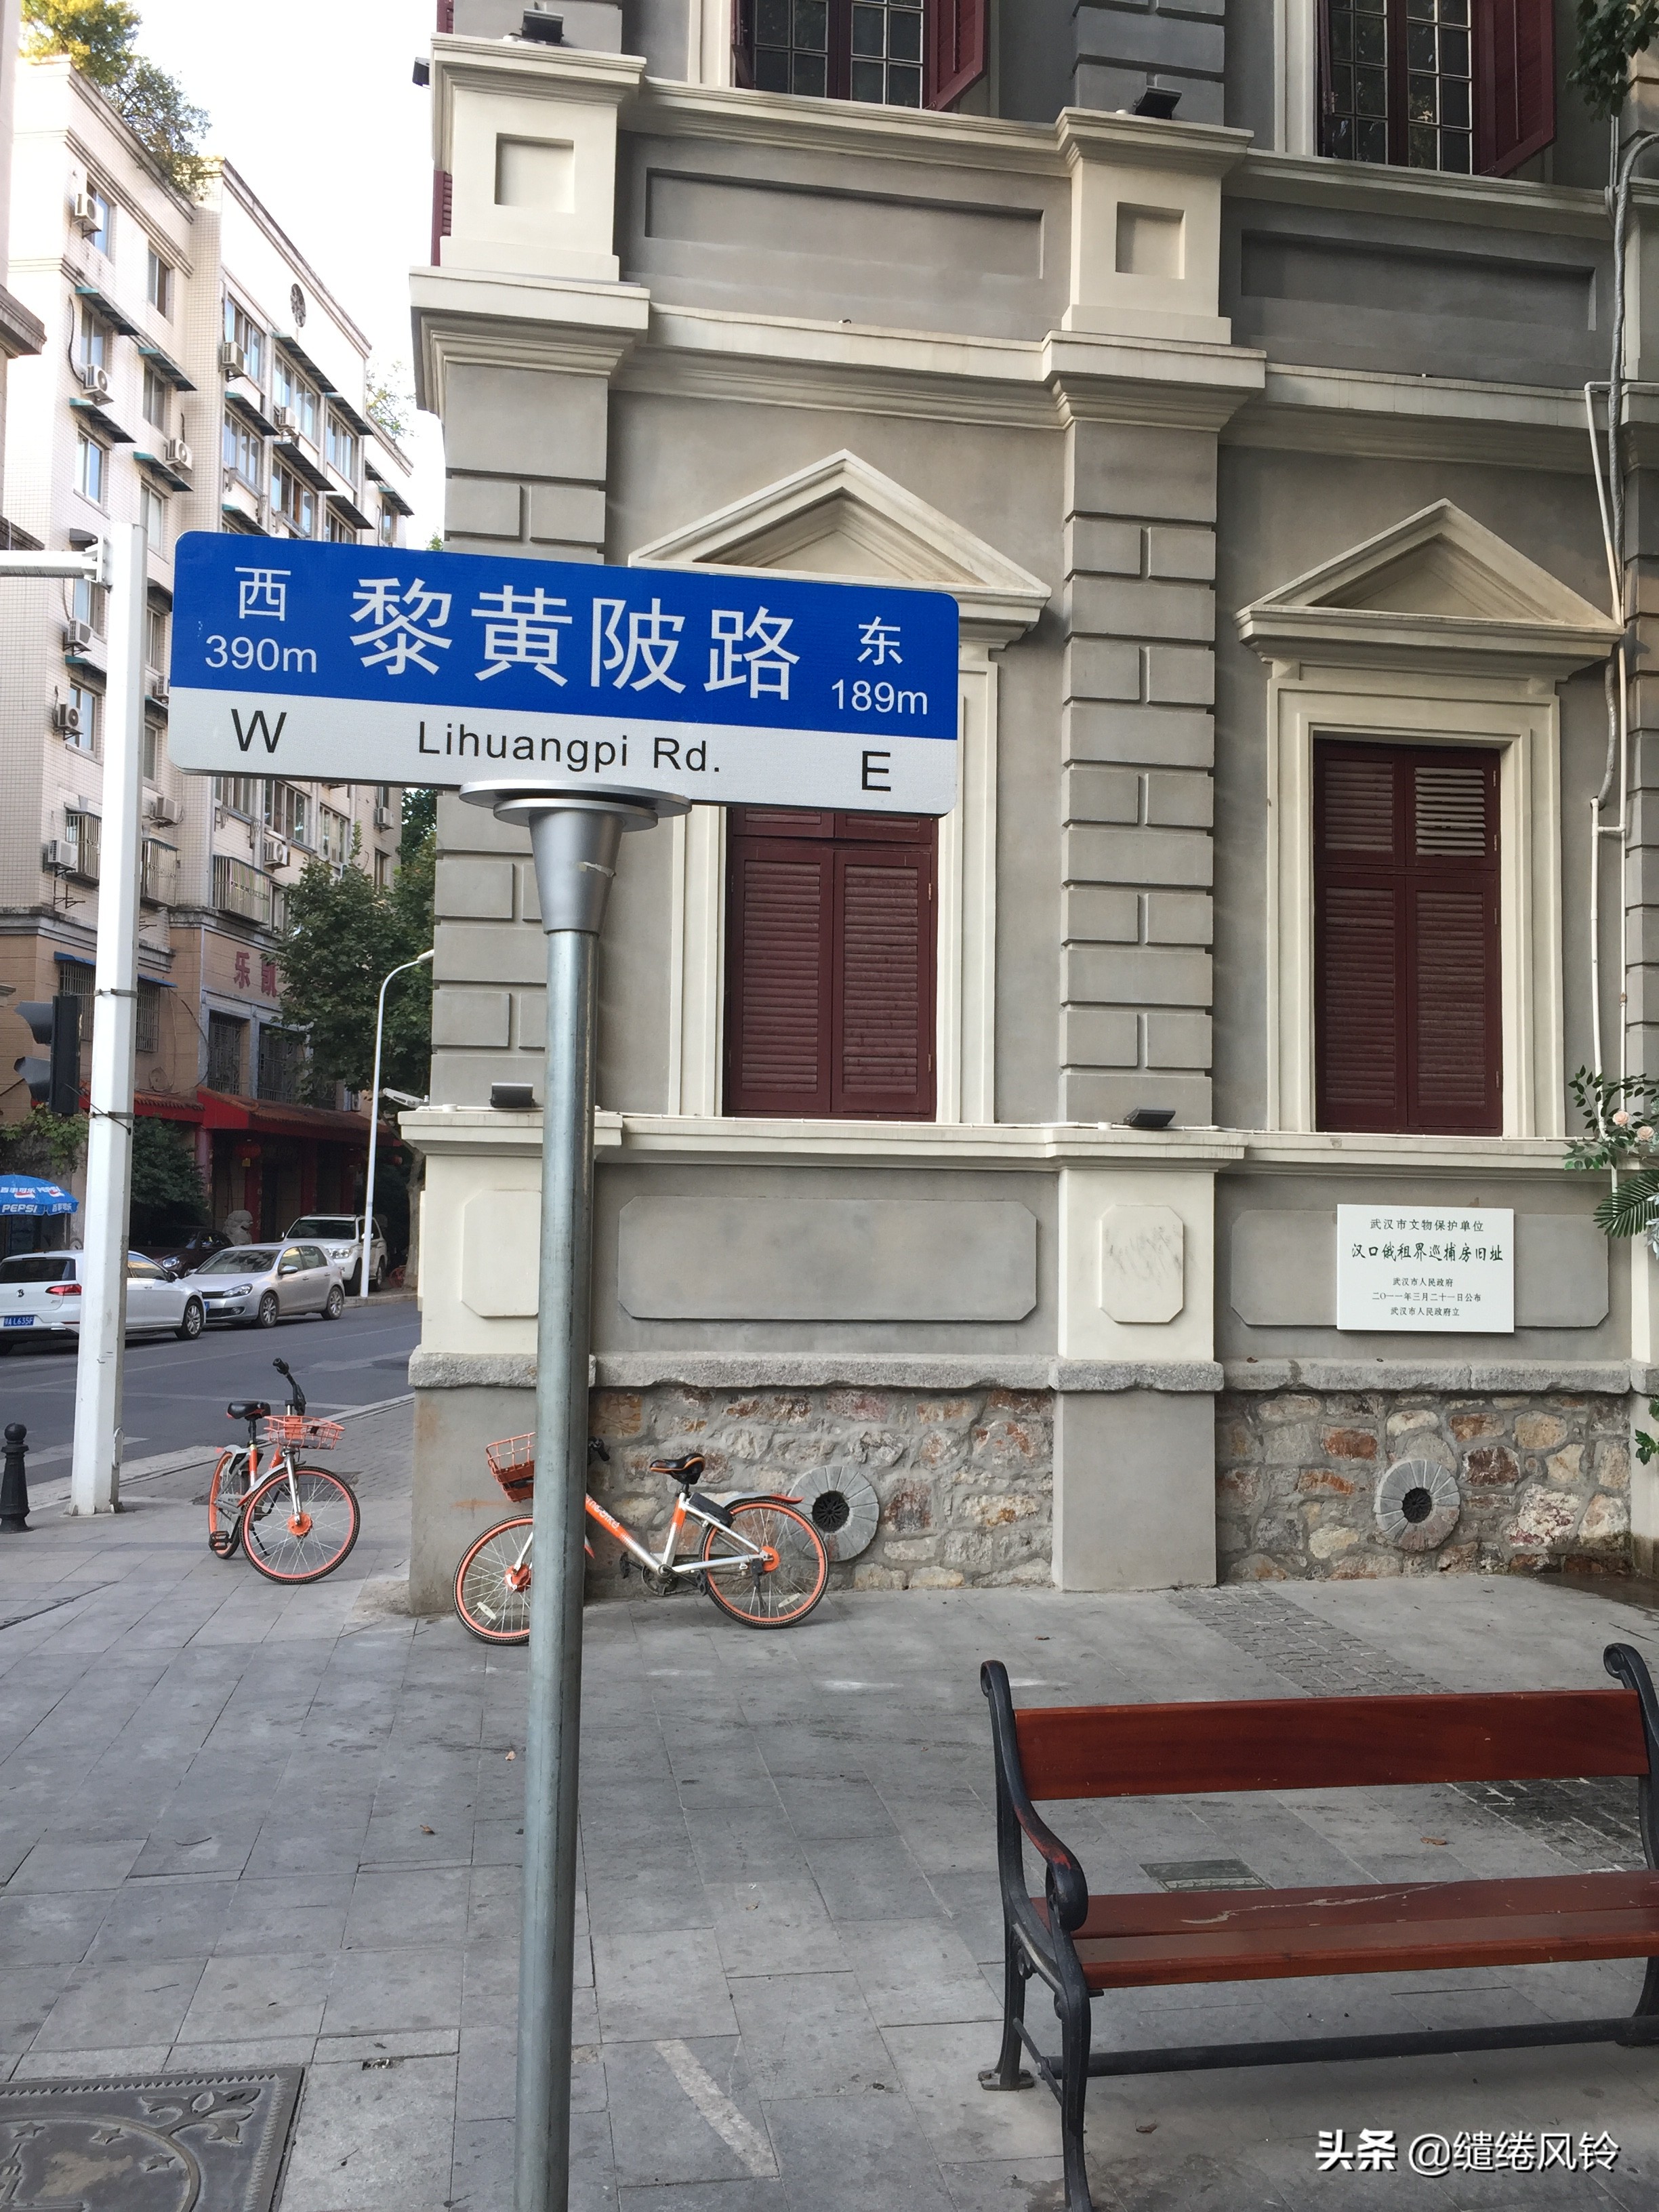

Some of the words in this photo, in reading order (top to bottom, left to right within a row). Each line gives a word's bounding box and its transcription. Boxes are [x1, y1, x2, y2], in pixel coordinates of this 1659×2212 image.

[235, 567, 291, 621] 西
[205, 635, 316, 673] 390m
[350, 577, 800, 701] 黎黄陂路
[857, 616, 903, 665] 东
[832, 679, 928, 715] 189m
[230, 708, 287, 754] W
[419, 721, 628, 773] Lihuangpi
[653, 737, 720, 773] Rd.
[861, 750, 892, 792] E
[1, 1204, 38, 1213] PEPSI
[1370, 1218, 1484, 1232] 武汉市文物保护单位
[1351, 1240, 1504, 1263] 汉口俄租界巡捕房旧址
[1392, 1277, 1454, 1288] 武汉市人民政府
[1390, 1307, 1460, 1317] 武汉市人民政府立
